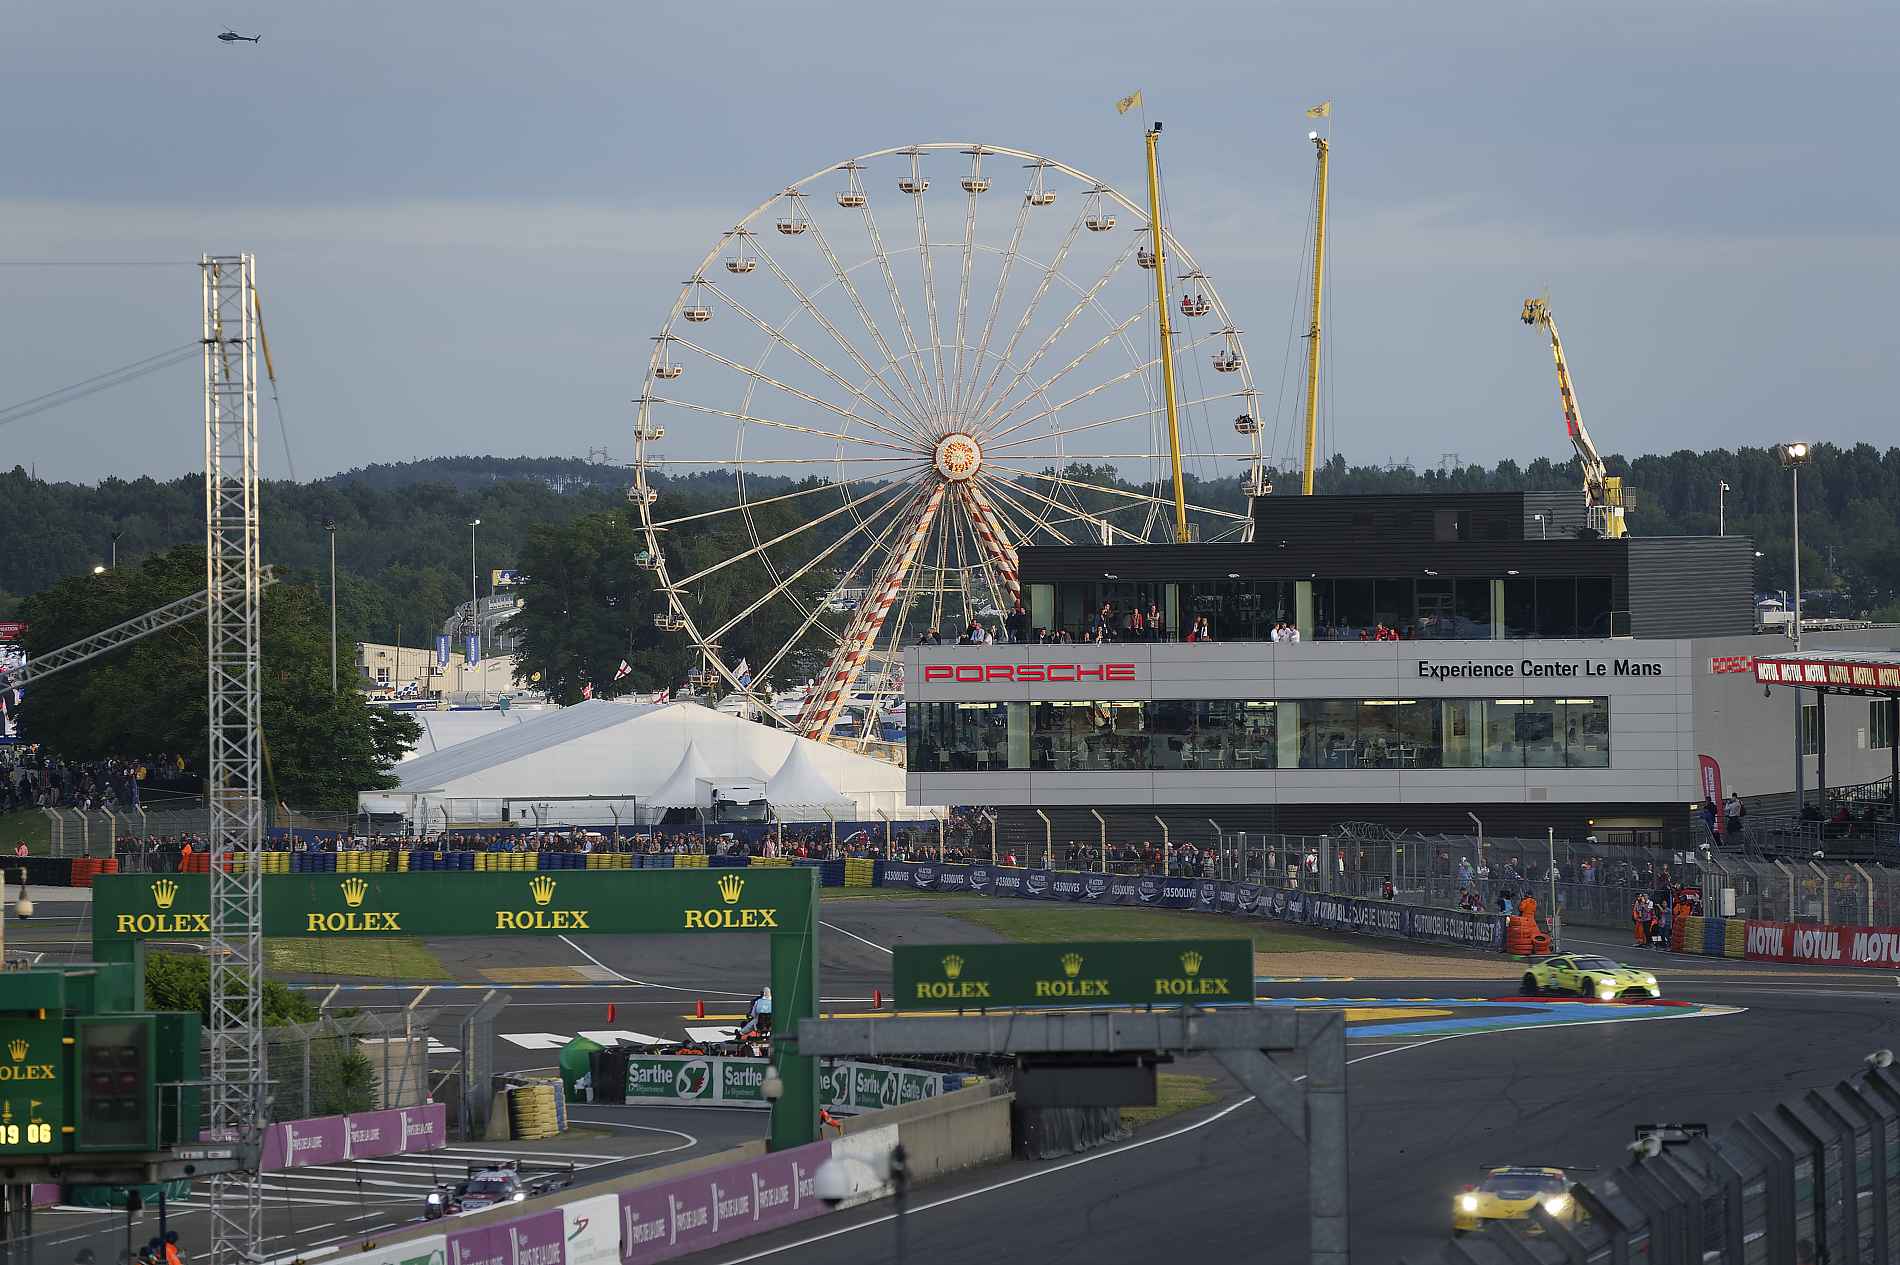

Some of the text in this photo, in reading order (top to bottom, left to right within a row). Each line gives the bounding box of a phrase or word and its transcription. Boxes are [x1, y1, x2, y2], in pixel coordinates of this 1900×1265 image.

[924, 663, 1136, 683] PORSCHE
[1418, 657, 1662, 682] Experience Center Le Mans
[1711, 656, 1753, 673] PORSCH
[1757, 663, 1779, 680] MOTUL
[1781, 664, 1802, 681] MOTUL
[1805, 665, 1827, 682] MOTUL
[1829, 666, 1851, 683] MOTUL
[1853, 667, 1876, 685] MOTUL
[116, 914, 210, 933] ROLEX
[307, 912, 401, 931] ROLEX
[495, 910, 589, 929] ROLEX
[684, 908, 778, 928] ROLEX
[1748, 925, 1900, 963] MOTUL MOTUL MOTU
[916, 981, 992, 999] ROLEX
[1035, 980, 1111, 997] ROLEX
[1155, 978, 1230, 995] ROLEX
[0, 1065, 56, 1081] OLEX
[628, 1062, 673, 1084] Sarthe
[725, 1065, 763, 1087] Sarthe
[28, 1123, 52, 1143] 06
